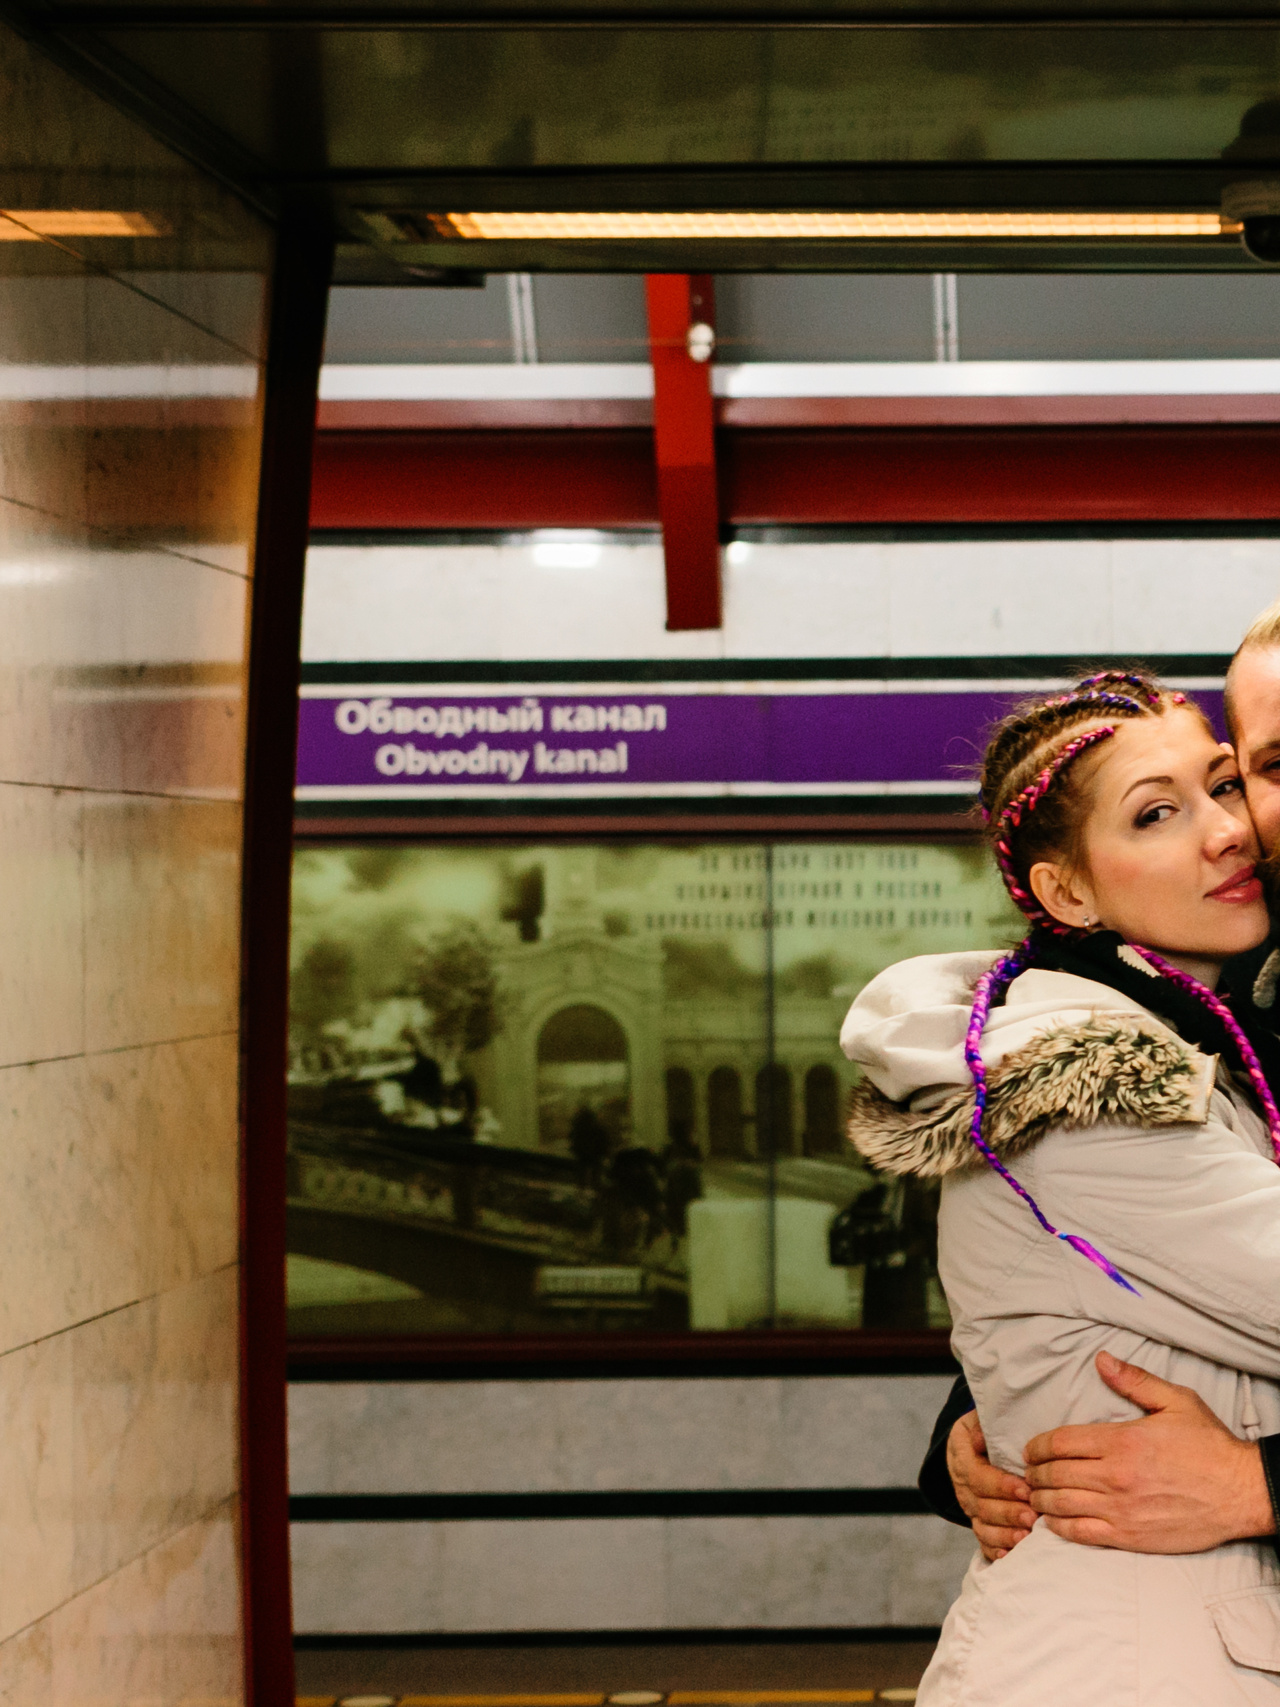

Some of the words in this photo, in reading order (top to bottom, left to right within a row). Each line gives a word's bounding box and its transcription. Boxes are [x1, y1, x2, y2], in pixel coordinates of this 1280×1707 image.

[335, 698, 543, 737] Обводный
[551, 703, 666, 732] канал
[375, 741, 529, 782] Obvodny
[534, 741, 628, 774] kanal
